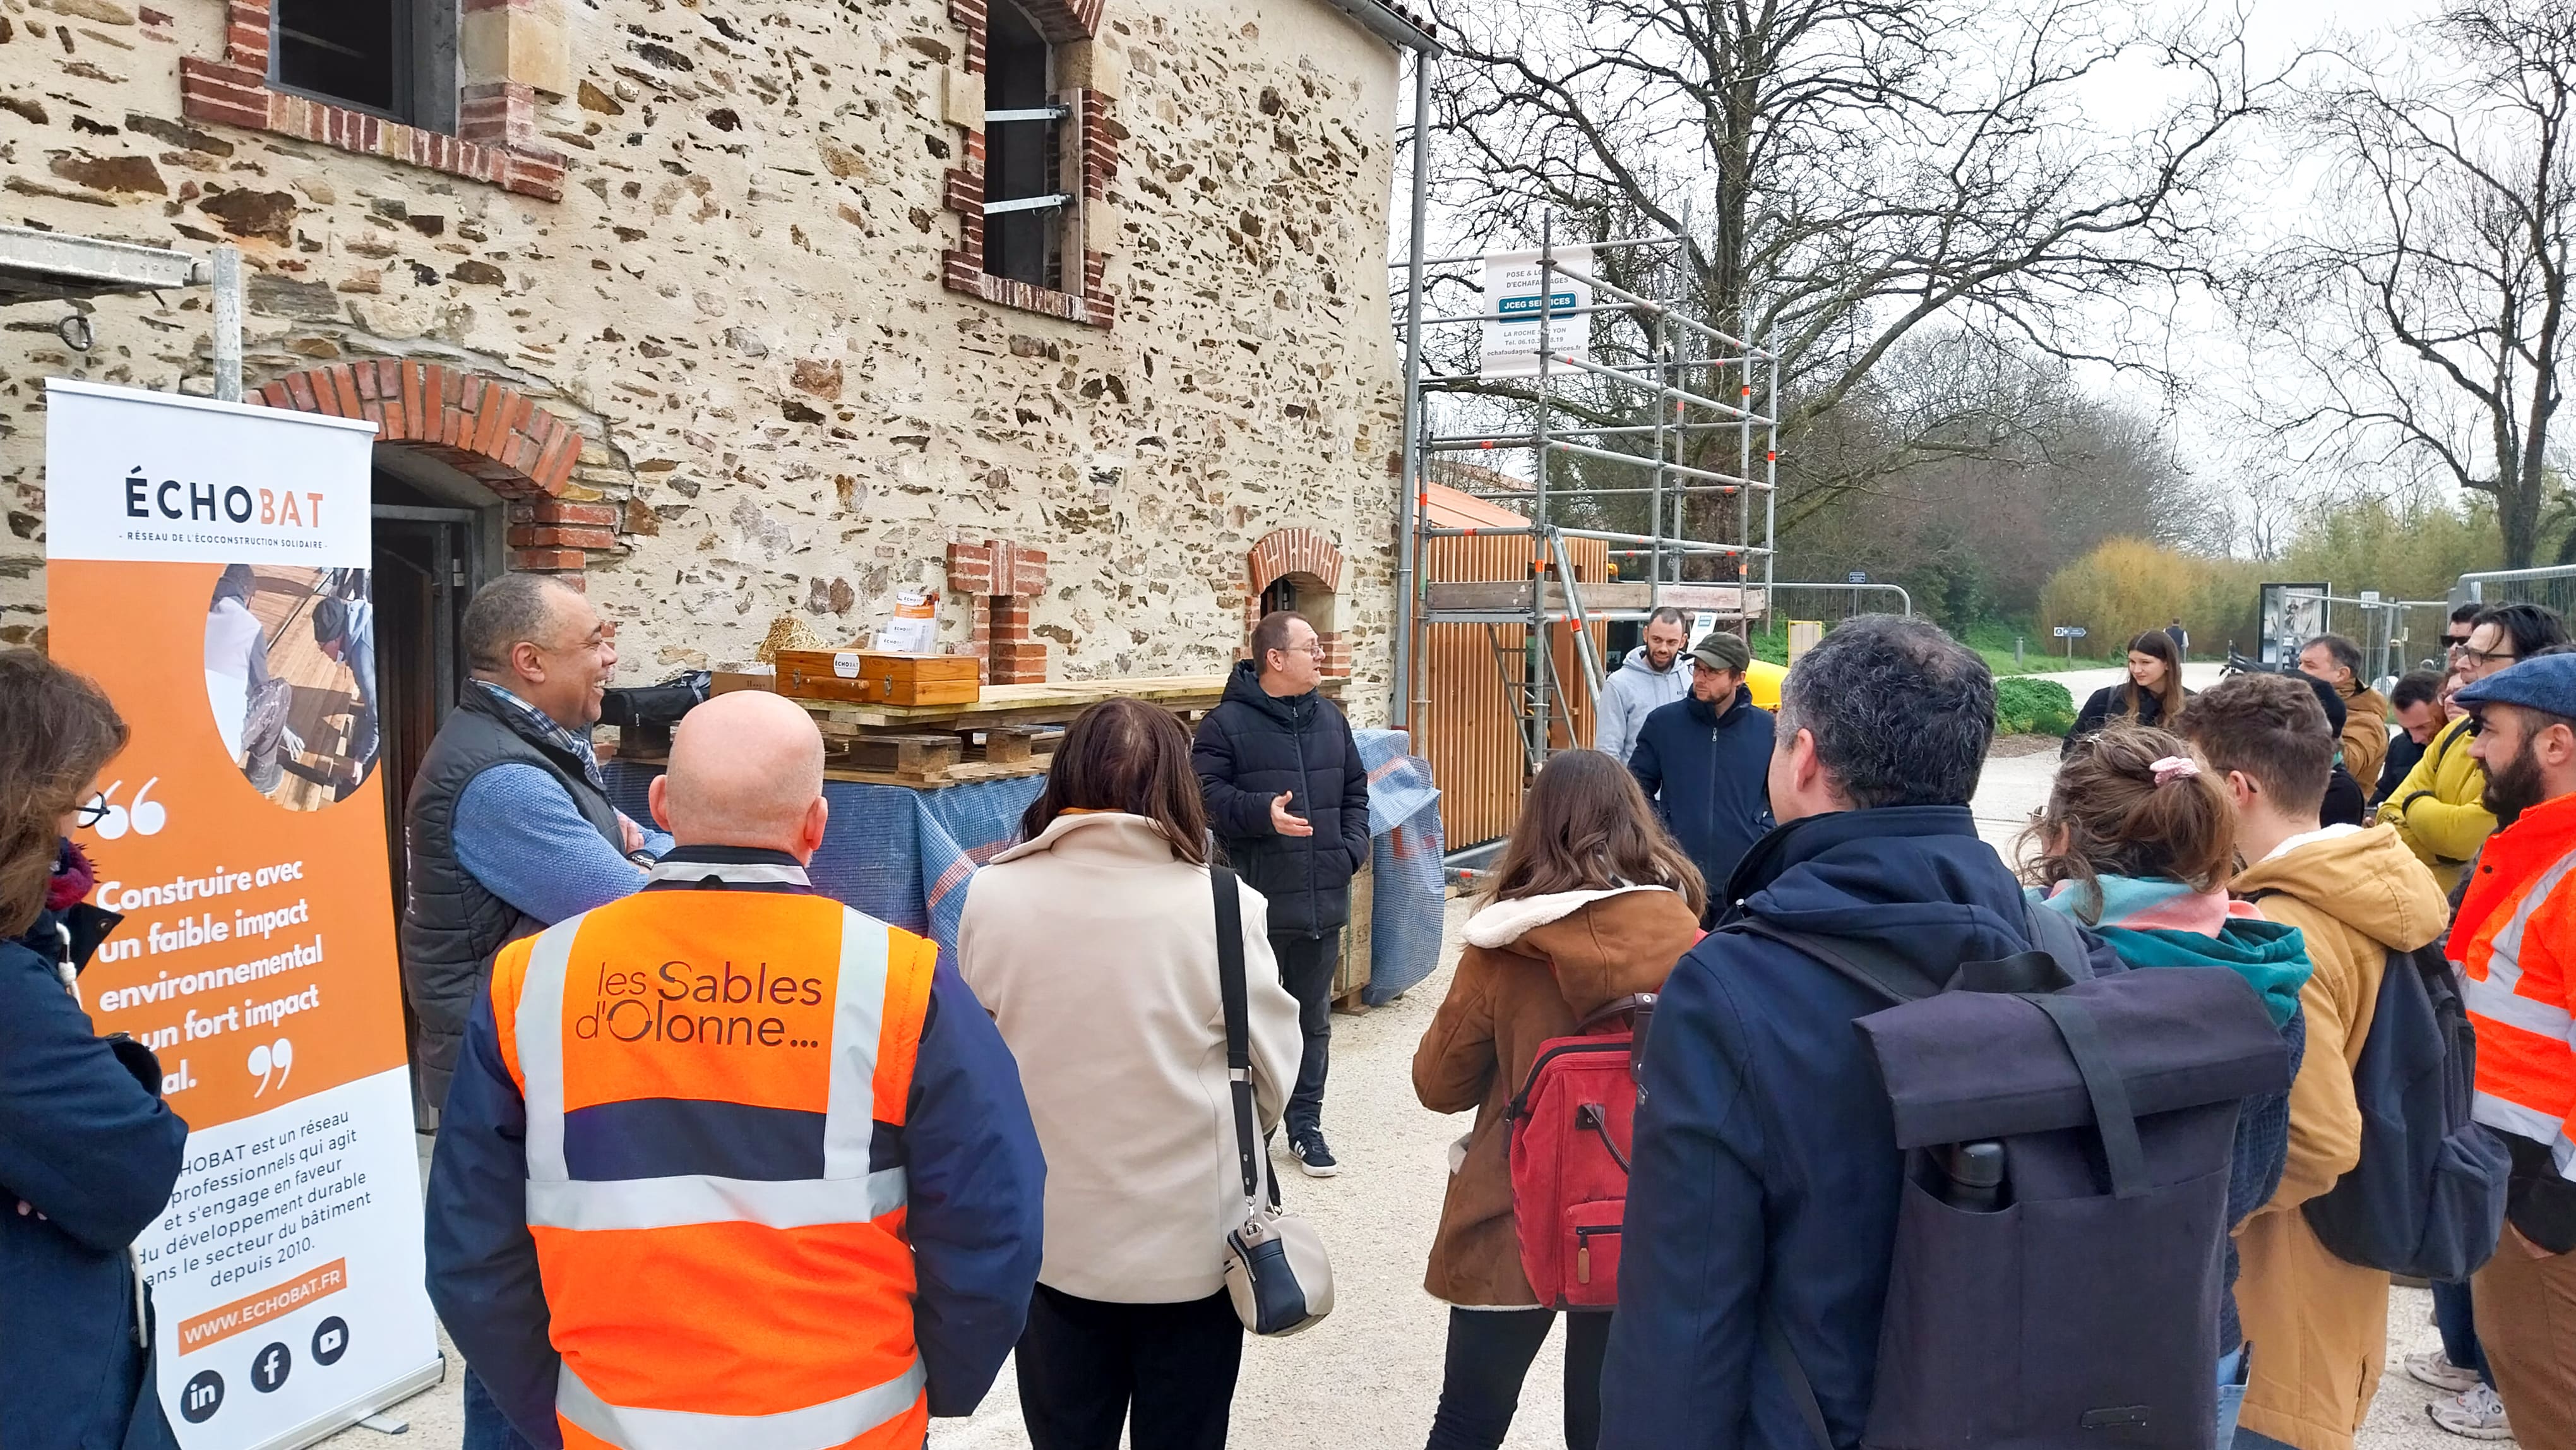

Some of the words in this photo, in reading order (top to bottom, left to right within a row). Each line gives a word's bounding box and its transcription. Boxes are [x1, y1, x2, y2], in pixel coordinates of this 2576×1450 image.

[1504, 301, 1527, 309] JCEG
[1529, 297, 1570, 308] SEICES
[1506, 277, 1568, 288] D'ECHAFAAGES
[125, 465, 324, 528] ÉCHOBAT
[128, 530, 168, 542] RÉSEAU
[172, 534, 184, 542] DE
[188, 533, 278, 547] L'ÉCOCONSTRUCTION
[281, 539, 323, 549] SOLIDAIRE
[96, 865, 251, 912] Construire
[255, 861, 303, 888] avec
[98, 938, 141, 963] un
[147, 913, 229, 954] faible
[234, 898, 308, 940] impact
[99, 934, 324, 1012] environnemental
[598, 962, 647, 997] les
[657, 961, 822, 1006] Sables
[141, 1026, 179, 1052] un
[184, 1006, 239, 1041] fort
[244, 984, 319, 1028] impact
[575, 999, 819, 1048] d'Olonne...
[171, 1153, 295, 1208] professionnels
[299, 1139, 323, 1162] qui
[328, 1129, 357, 1151] agit
[181, 1144, 246, 1177] HOBAT
[252, 1136, 275, 1155] est
[278, 1130, 296, 1146] un
[300, 1111, 349, 1137] réseau
[164, 1214, 182, 1231] et
[188, 1187, 270, 1223] s'engage
[274, 1178, 290, 1194] en
[295, 1159, 342, 1185] faveur
[166, 1194, 303, 1255] développement
[307, 1172, 366, 1203] durable
[145, 1266, 177, 1287] ans
[184, 1258, 200, 1273] le
[206, 1232, 273, 1265] secteur
[278, 1223, 297, 1239] du
[301, 1192, 371, 1229] bâtiment
[211, 1255, 272, 1287] depuis
[278, 1237, 315, 1263] 2010.
[184, 1270, 340, 1343] WWW.ECHOBAT.FR
